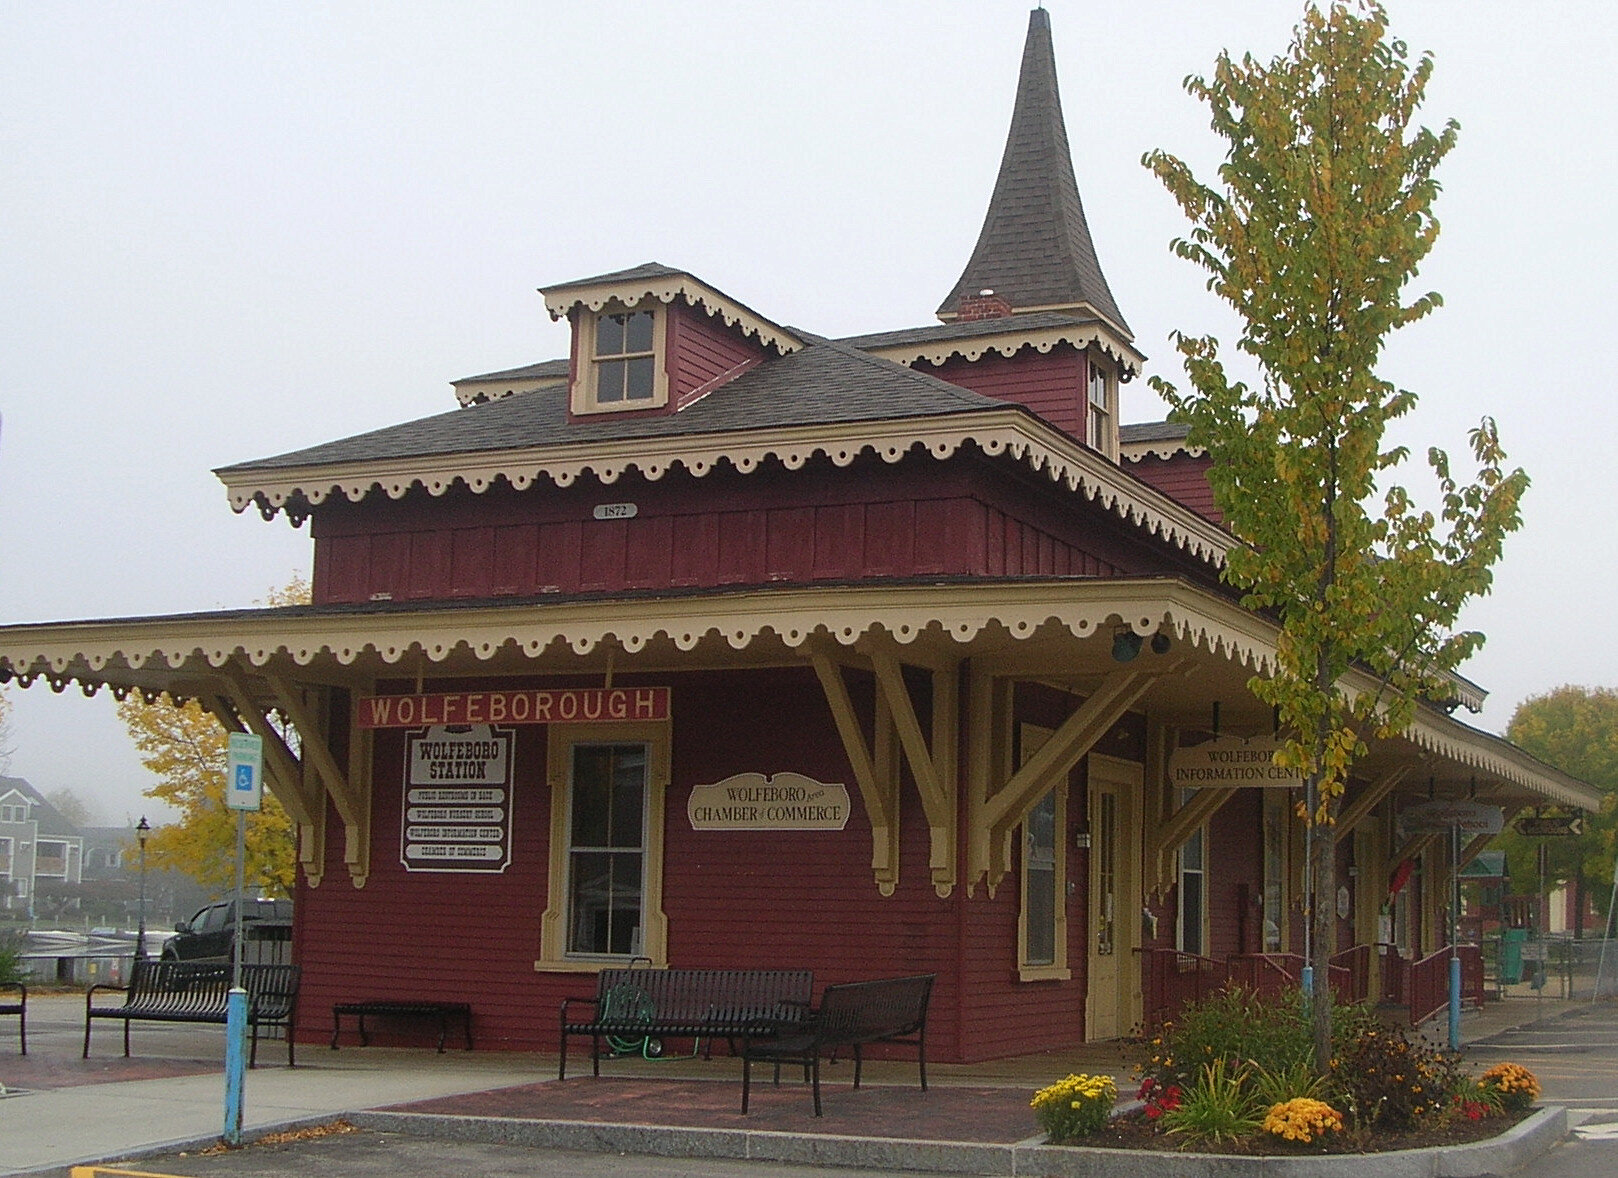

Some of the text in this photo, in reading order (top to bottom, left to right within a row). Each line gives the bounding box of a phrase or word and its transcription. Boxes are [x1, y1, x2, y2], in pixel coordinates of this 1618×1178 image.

[604, 505, 627, 517] 1872
[370, 689, 656, 725] WOLFEBOROUGH
[419, 741, 499, 760] WOLFEBORO
[1208, 750, 1274, 762] WOLFEBOR
[430, 761, 487, 779] STATION
[1176, 766, 1300, 781] INFORMATION CENT
[727, 787, 806, 801] WOLFEBORO
[694, 806, 758, 821] CHAMBER
[767, 805, 841, 820] COMMERCE
